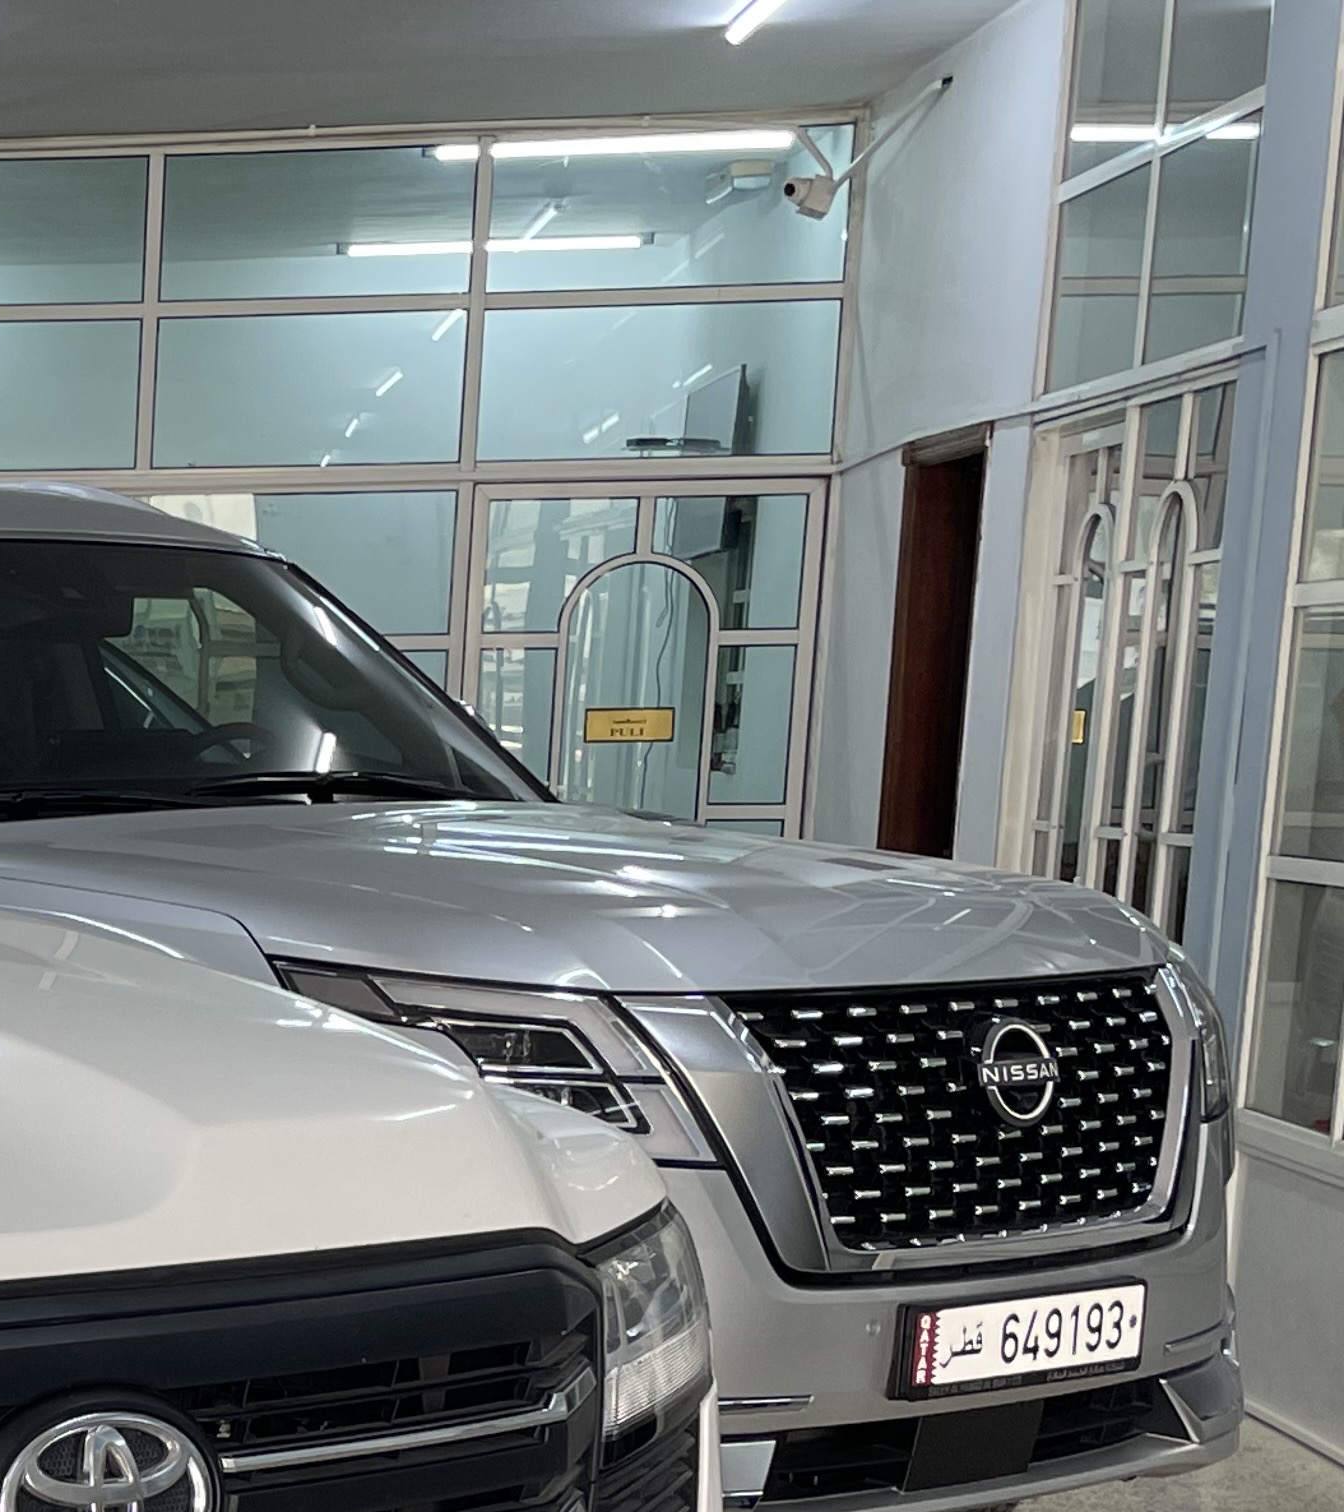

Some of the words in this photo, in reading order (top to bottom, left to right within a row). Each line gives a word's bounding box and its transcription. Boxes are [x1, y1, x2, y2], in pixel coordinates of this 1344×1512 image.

[981, 1062, 1059, 1083] NISSAN
[916, 1315, 932, 1384] QATAR
[940, 1321, 983, 1369] قطر
[1001, 1300, 1124, 1364] 649193
